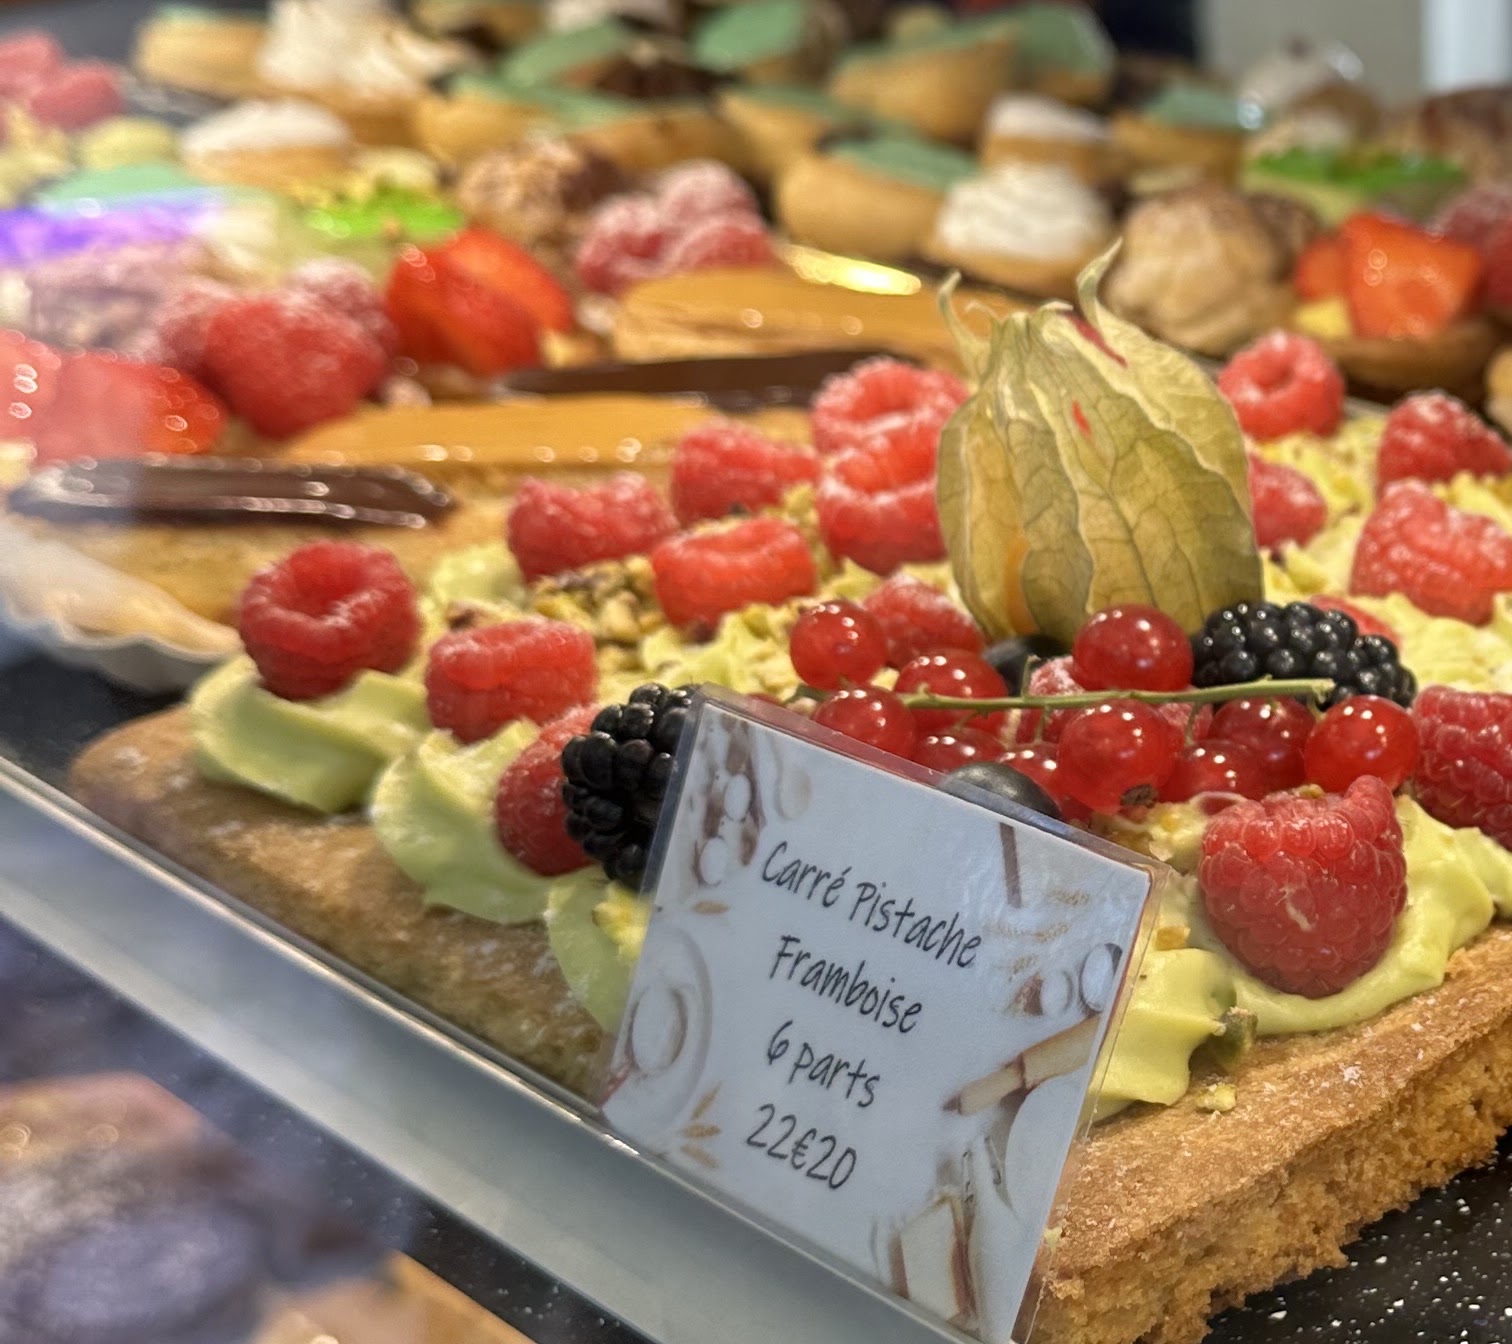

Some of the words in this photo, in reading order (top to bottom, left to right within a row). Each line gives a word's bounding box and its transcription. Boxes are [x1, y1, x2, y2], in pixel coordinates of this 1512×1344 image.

[761, 841, 852, 908] Carré
[849, 882, 982, 968] Pistache
[769, 935, 924, 1033] Framboise
[767, 1020, 790, 1064] 6
[789, 1041, 880, 1109] parts
[746, 1104, 857, 1190] 22€20
